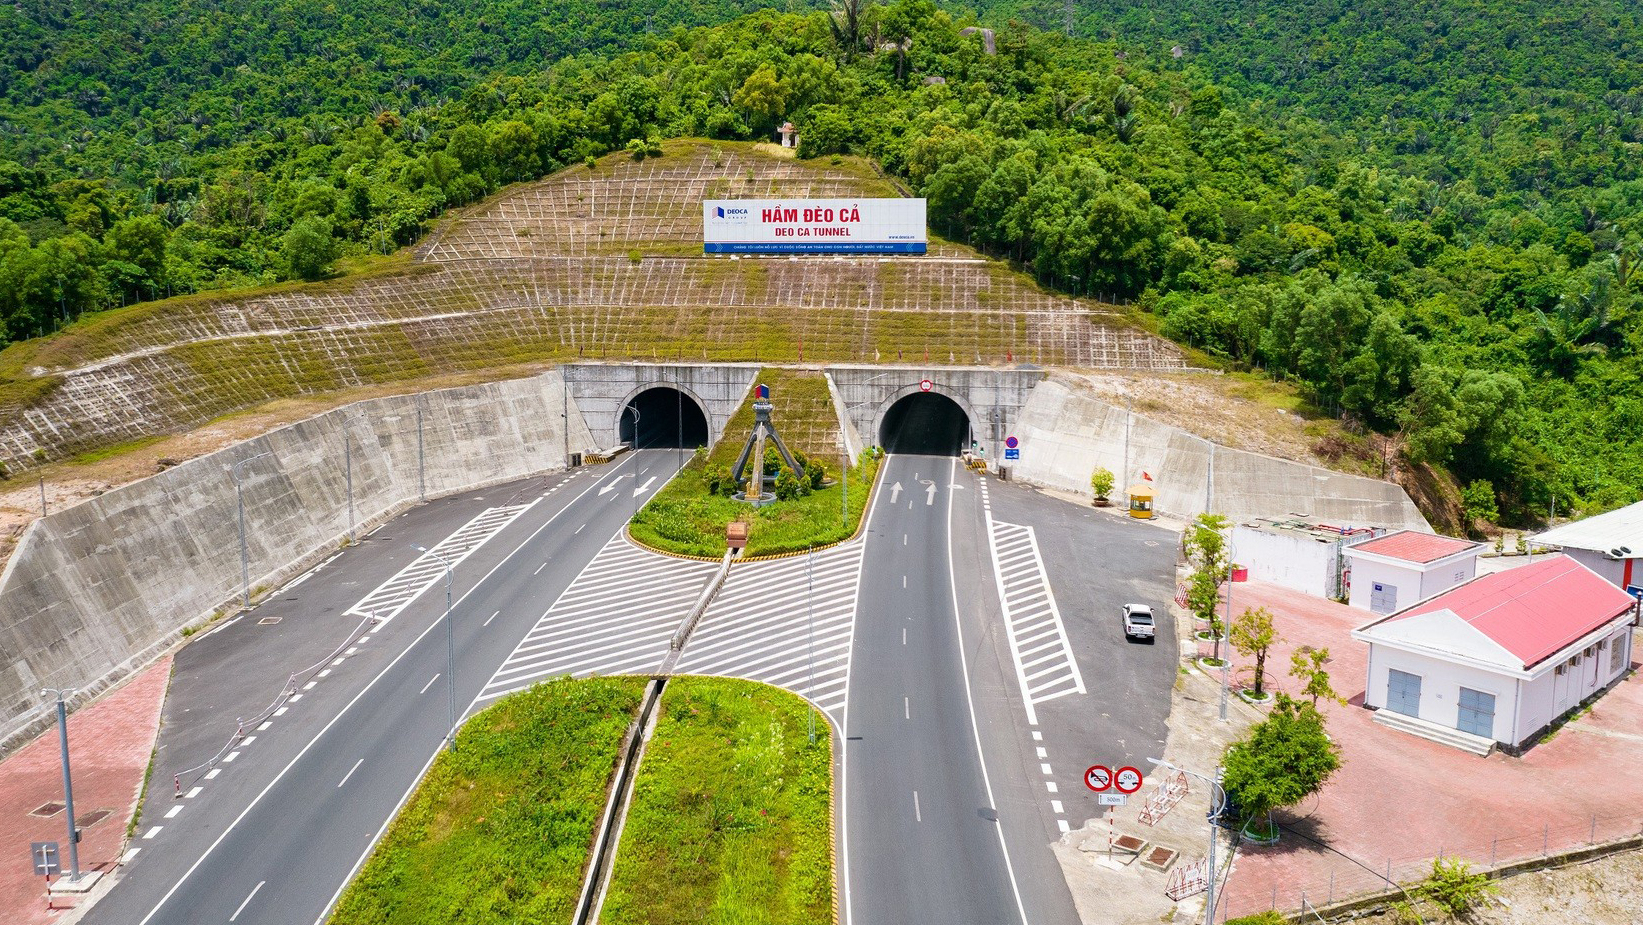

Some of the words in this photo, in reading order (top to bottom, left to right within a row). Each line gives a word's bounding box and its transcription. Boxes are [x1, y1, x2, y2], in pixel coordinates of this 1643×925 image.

[762, 204, 798, 222] HẦM
[803, 205, 834, 222] ĐÈO
[839, 204, 860, 222] CẢ
[775, 227, 794, 236] DEO
[797, 227, 810, 236] CA
[813, 227, 851, 236] TUNNEL
